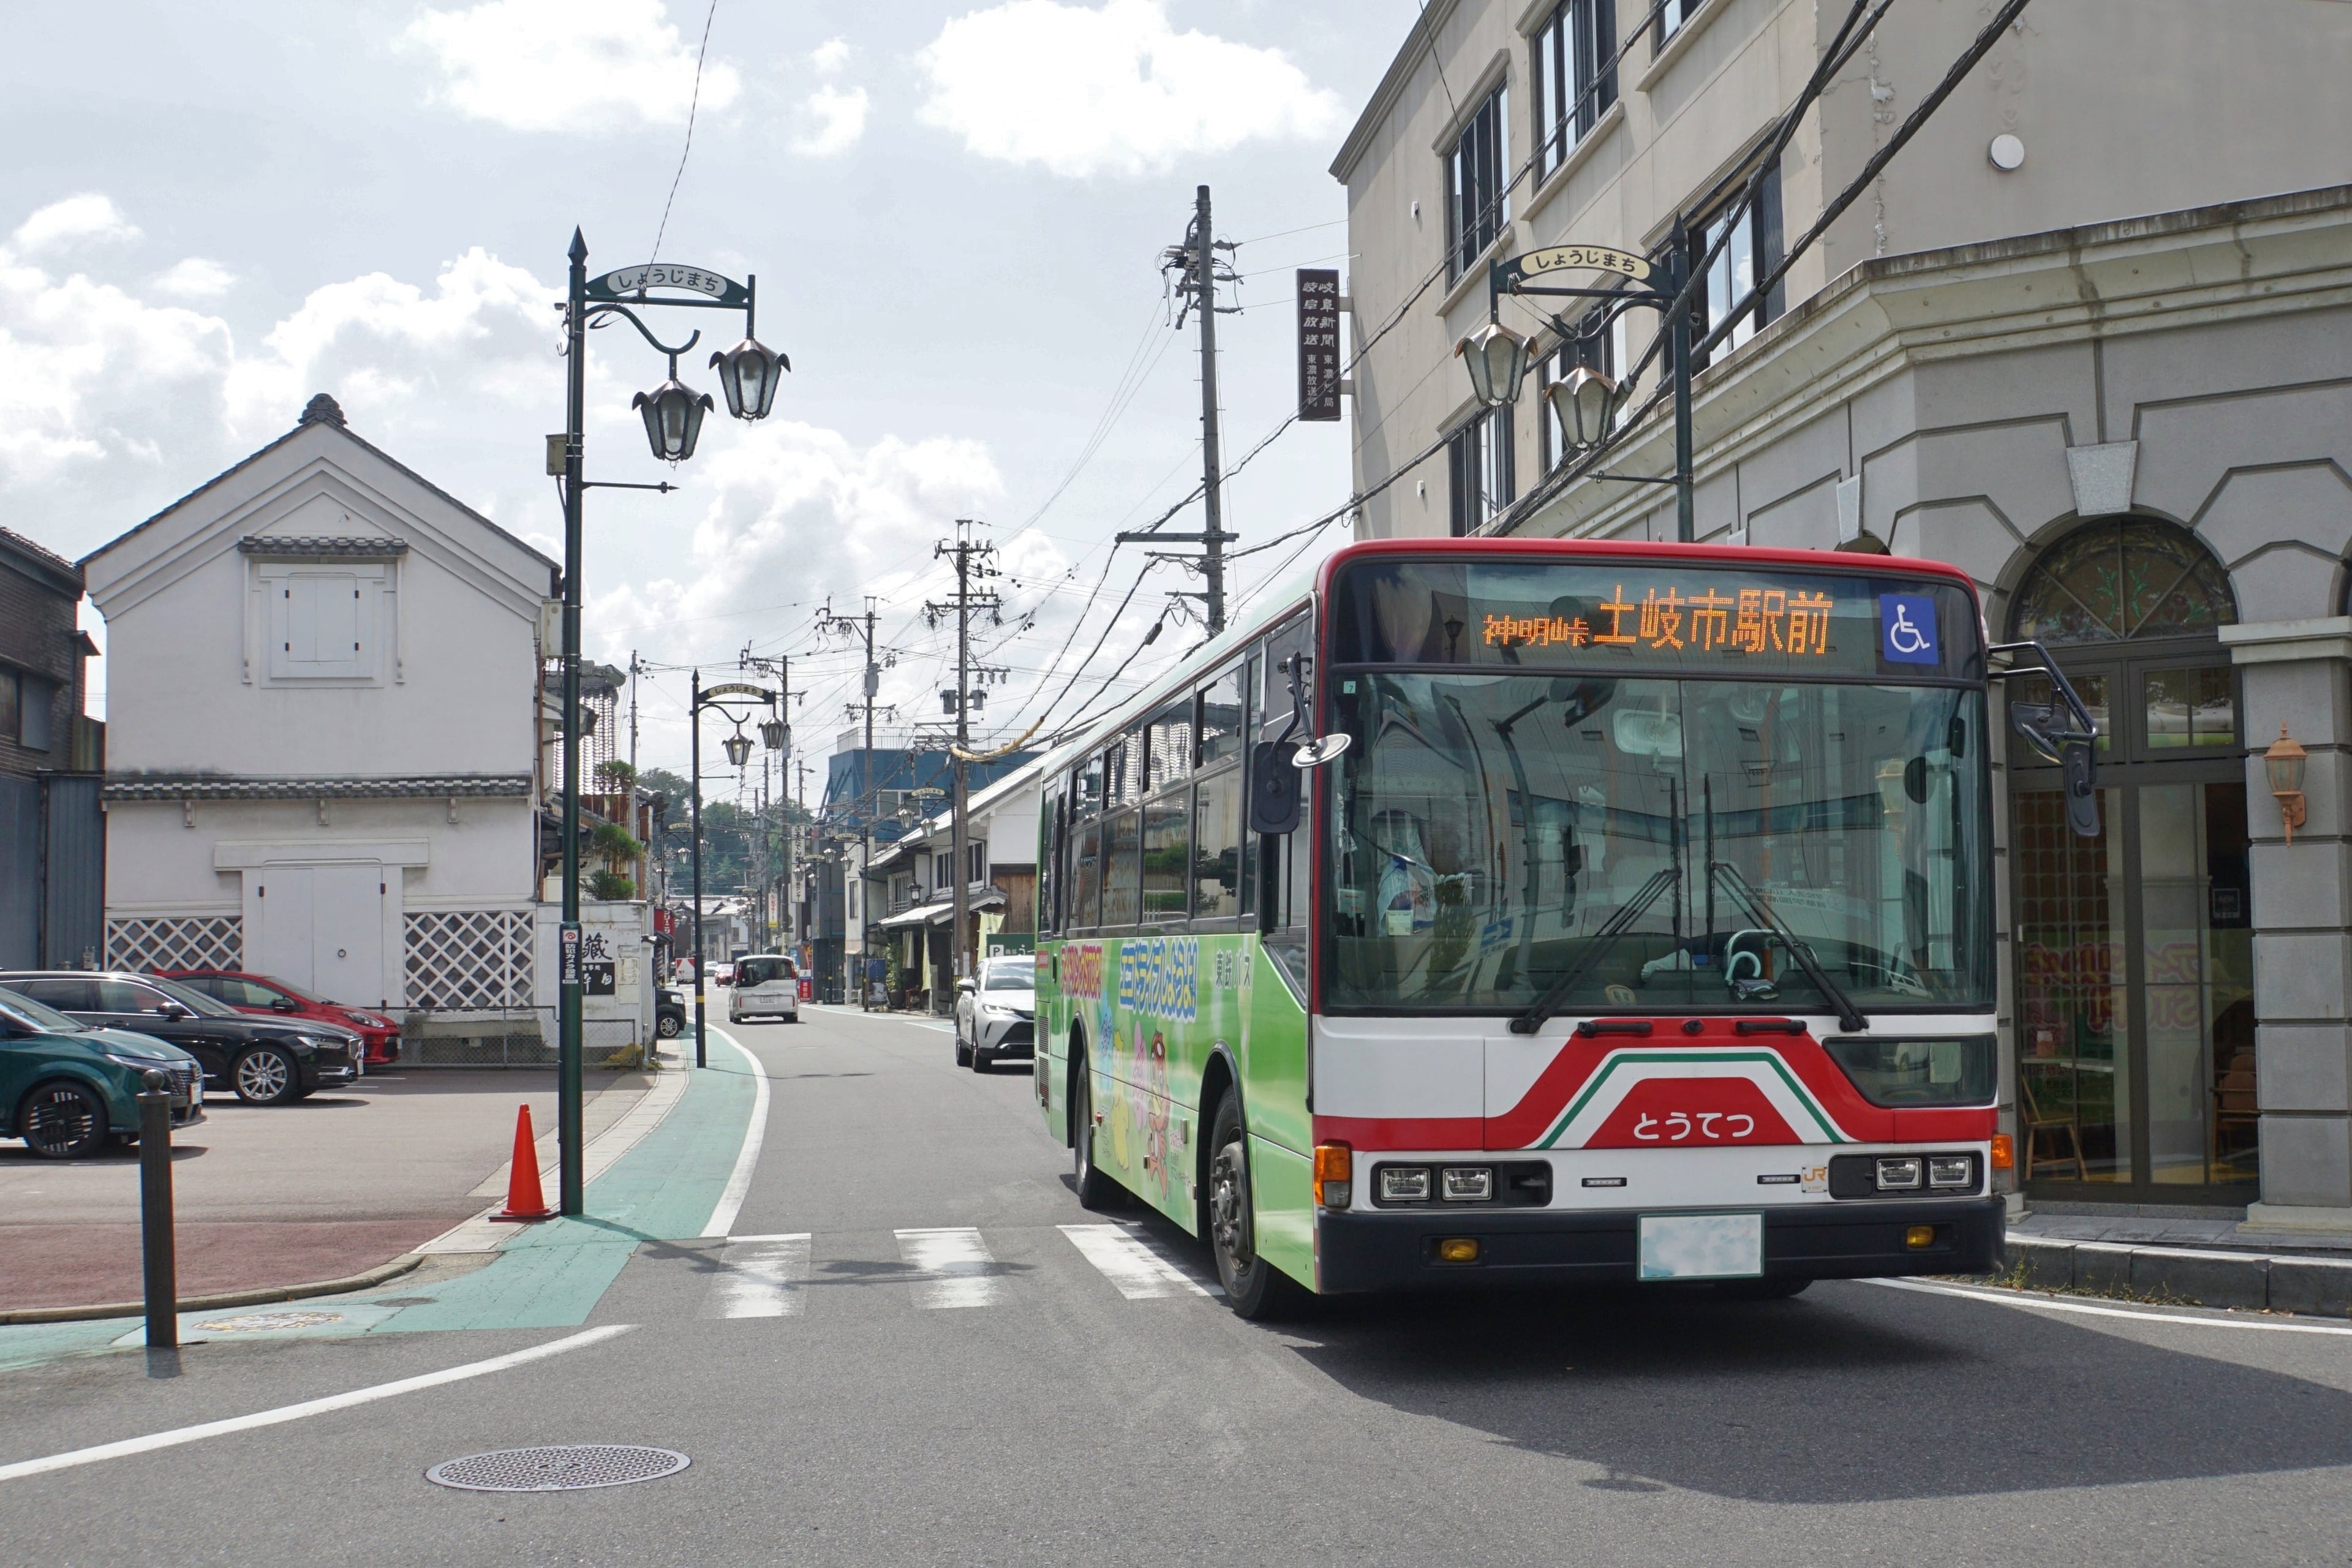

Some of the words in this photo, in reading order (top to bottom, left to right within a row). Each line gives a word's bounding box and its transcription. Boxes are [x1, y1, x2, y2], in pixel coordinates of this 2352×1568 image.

[1535, 249, 1636, 273] しょうじまち
[618, 268, 719, 292] しょうじまち
[1302, 281, 1319, 346] 岐阜放送
[1317, 281, 1336, 348] 岐阜新聞
[1482, 614, 1589, 647] 神明峠
[1594, 584, 1834, 655] 土岐市駅前
[565, 943, 576, 979] 防犯カメラ設置
[1216, 951, 1250, 987] 東鉄バス
[1634, 1112, 1754, 1140] とうてつ
[1803, 1168, 1826, 1182] JR
